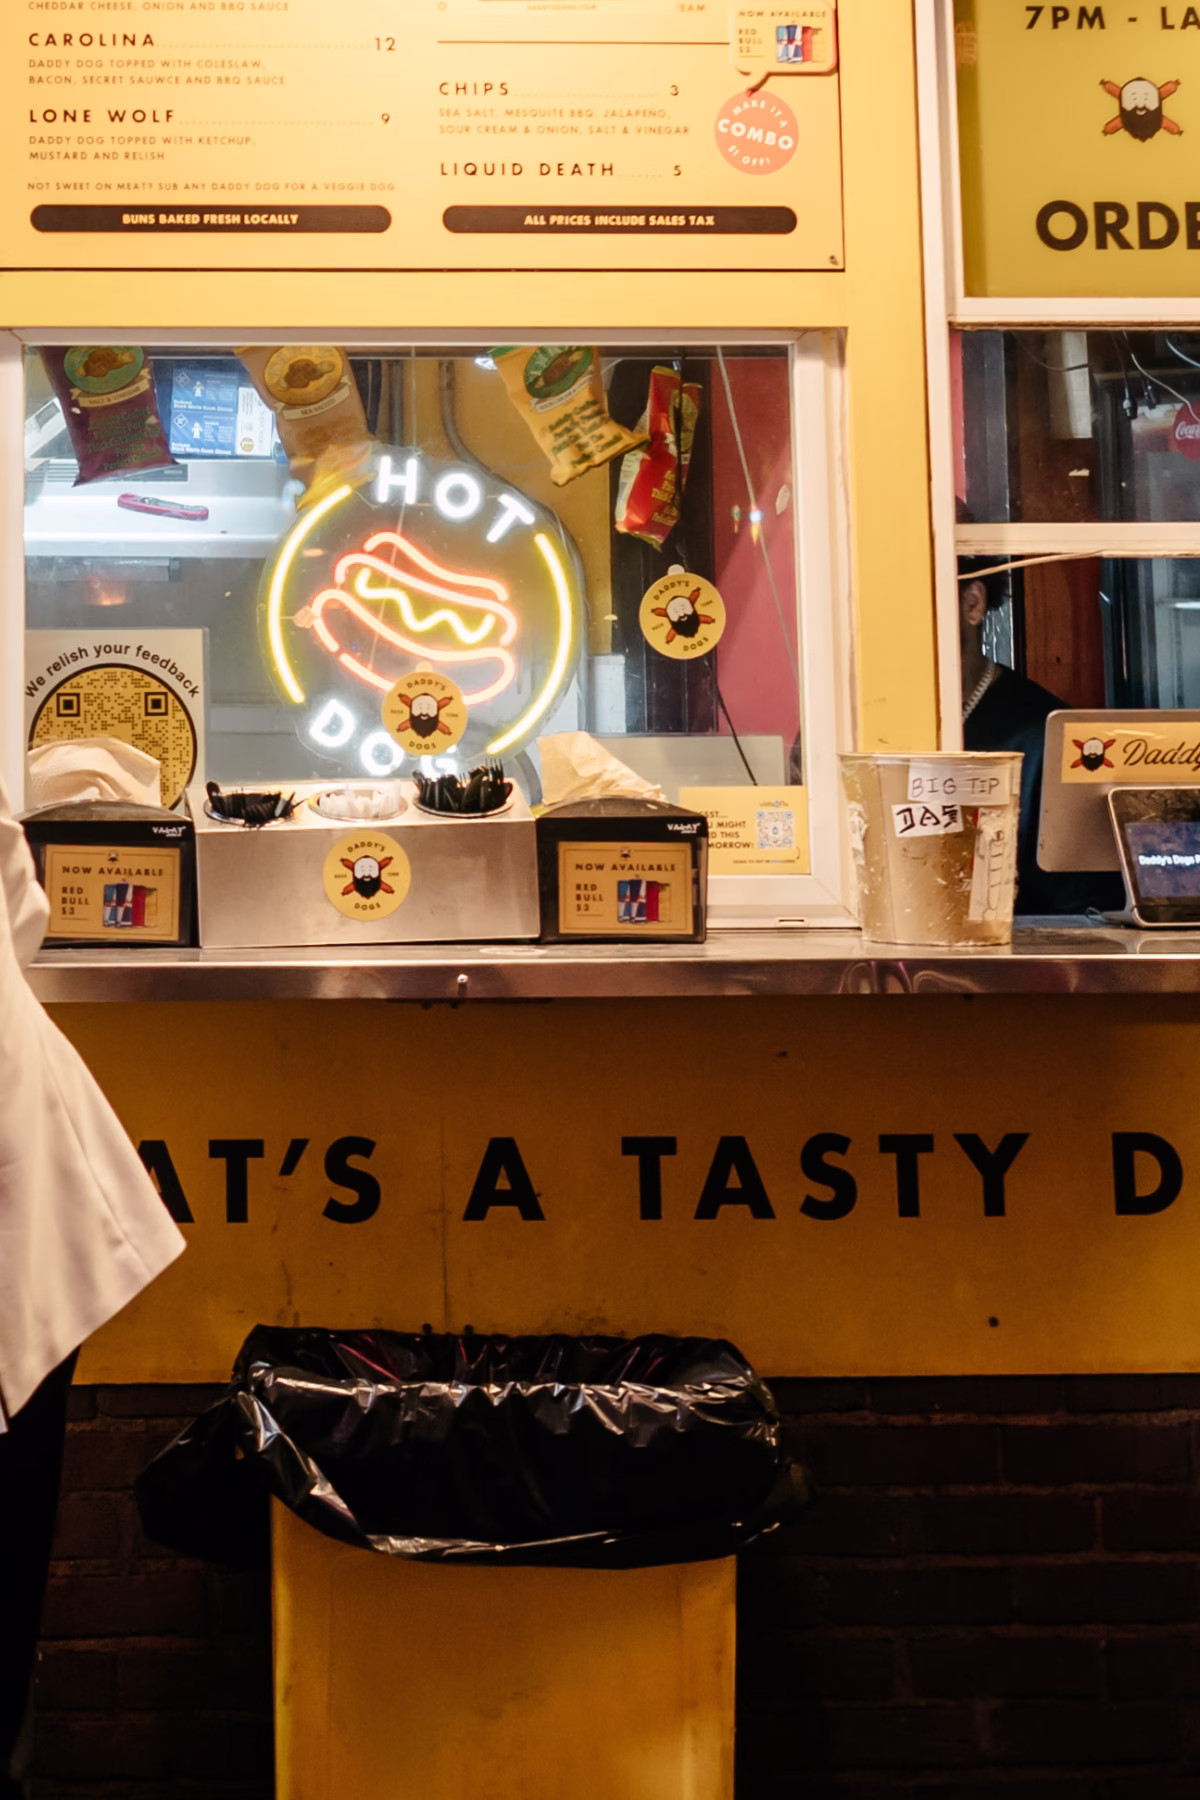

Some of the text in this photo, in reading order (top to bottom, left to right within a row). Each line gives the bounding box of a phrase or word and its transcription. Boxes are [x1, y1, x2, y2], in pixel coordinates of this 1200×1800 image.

[27, 1, 84, 11] CHEDDAR
[141, 1, 185, 11] ONION
[189, 1, 216, 11] AND
[220, 1, 245, 11] BBQ
[251, 1, 289, 11] SAUCE
[1025, 5, 1106, 30] 7PM
[28, 33, 155, 47] CAROLINA
[439, 81, 509, 96] CHIPS
[732, 99, 766, 116] MAKE
[770, 105, 783, 118] IT
[29, 109, 91, 123] LONE
[107, 109, 173, 123] WOLF
[29, 135, 71, 145] DADDY
[77, 135, 105, 145] DOG
[110, 135, 157, 145] TOPPED
[161, 135, 193, 145] WITH
[717, 118, 794, 151] COMBO
[29, 151, 165, 161] MUSTARD AND RELISH
[440, 162, 523, 177] LIQUID
[539, 162, 613, 177] DEATH
[27, 181, 50, 191] NOT
[55, 182, 90, 191] SWEET
[95, 182, 112, 191] ON
[117, 182, 153, 191] MEAT?
[157, 182, 179, 191] SUB
[211, 182, 250, 191] DADDY
[255, 182, 281, 191] DOG
[285, 182, 305, 191] FOR
[311, 183, 319, 191] A
[323, 182, 365, 191] VEGGIE
[369, 182, 395, 191] DOG
[122, 213, 299, 225] BUNS BAKED FRESH LOCALLY
[523, 214, 715, 226] ALL PRICES INCLUDE SALES TAX
[376, 455, 535, 543] HOT
[25, 644, 200, 699] We relish your feedback
[912, 777, 1000, 798] BIG TIP
[716, 820, 747, 829] MIGHT
[61, 865, 164, 877] NOW AVAILABLE
[574, 863, 676, 872] NOW AVAILABLE
[61, 886, 84, 895] RED
[575, 883, 598, 891] RED
[61, 896, 91, 906] BULL
[575, 893, 604, 902] BULL
[462, 1137, 546, 1221] A
[621, 1131, 1031, 1221] TASTY
